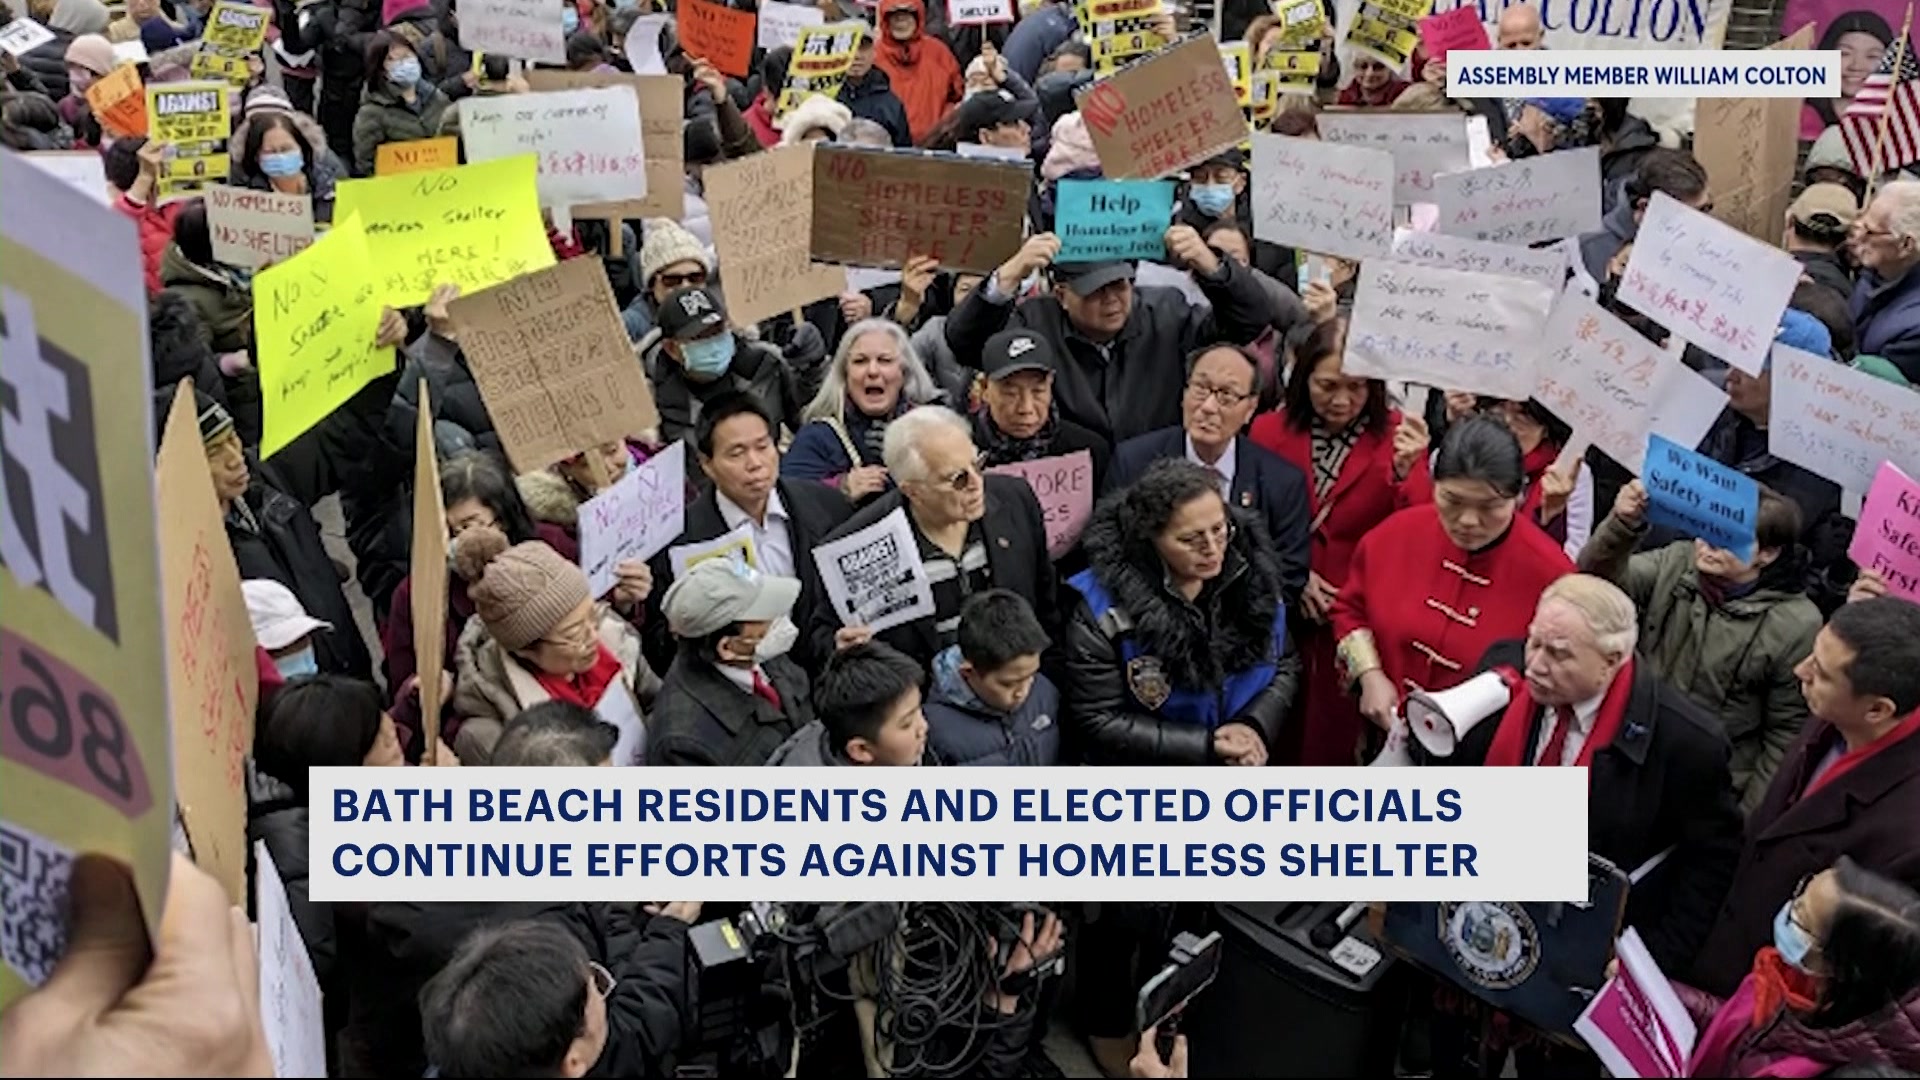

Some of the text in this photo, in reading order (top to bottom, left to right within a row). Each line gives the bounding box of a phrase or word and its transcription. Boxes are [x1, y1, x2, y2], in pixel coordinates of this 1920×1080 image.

[1082, 71, 1223, 138] NO HOMELESS
[1130, 110, 1216, 161] SHELTER
[828, 152, 866, 181] NO
[411, 175, 458, 197] NO
[864, 180, 1007, 212] HOMELESS
[1090, 194, 1141, 216] Help
[857, 206, 990, 238] SHELTER
[1021, 464, 1087, 498] ORE
[1696, 461, 1738, 493] Want
[1649, 467, 1745, 525] Safety and
[1877, 518, 1920, 560] Safe
